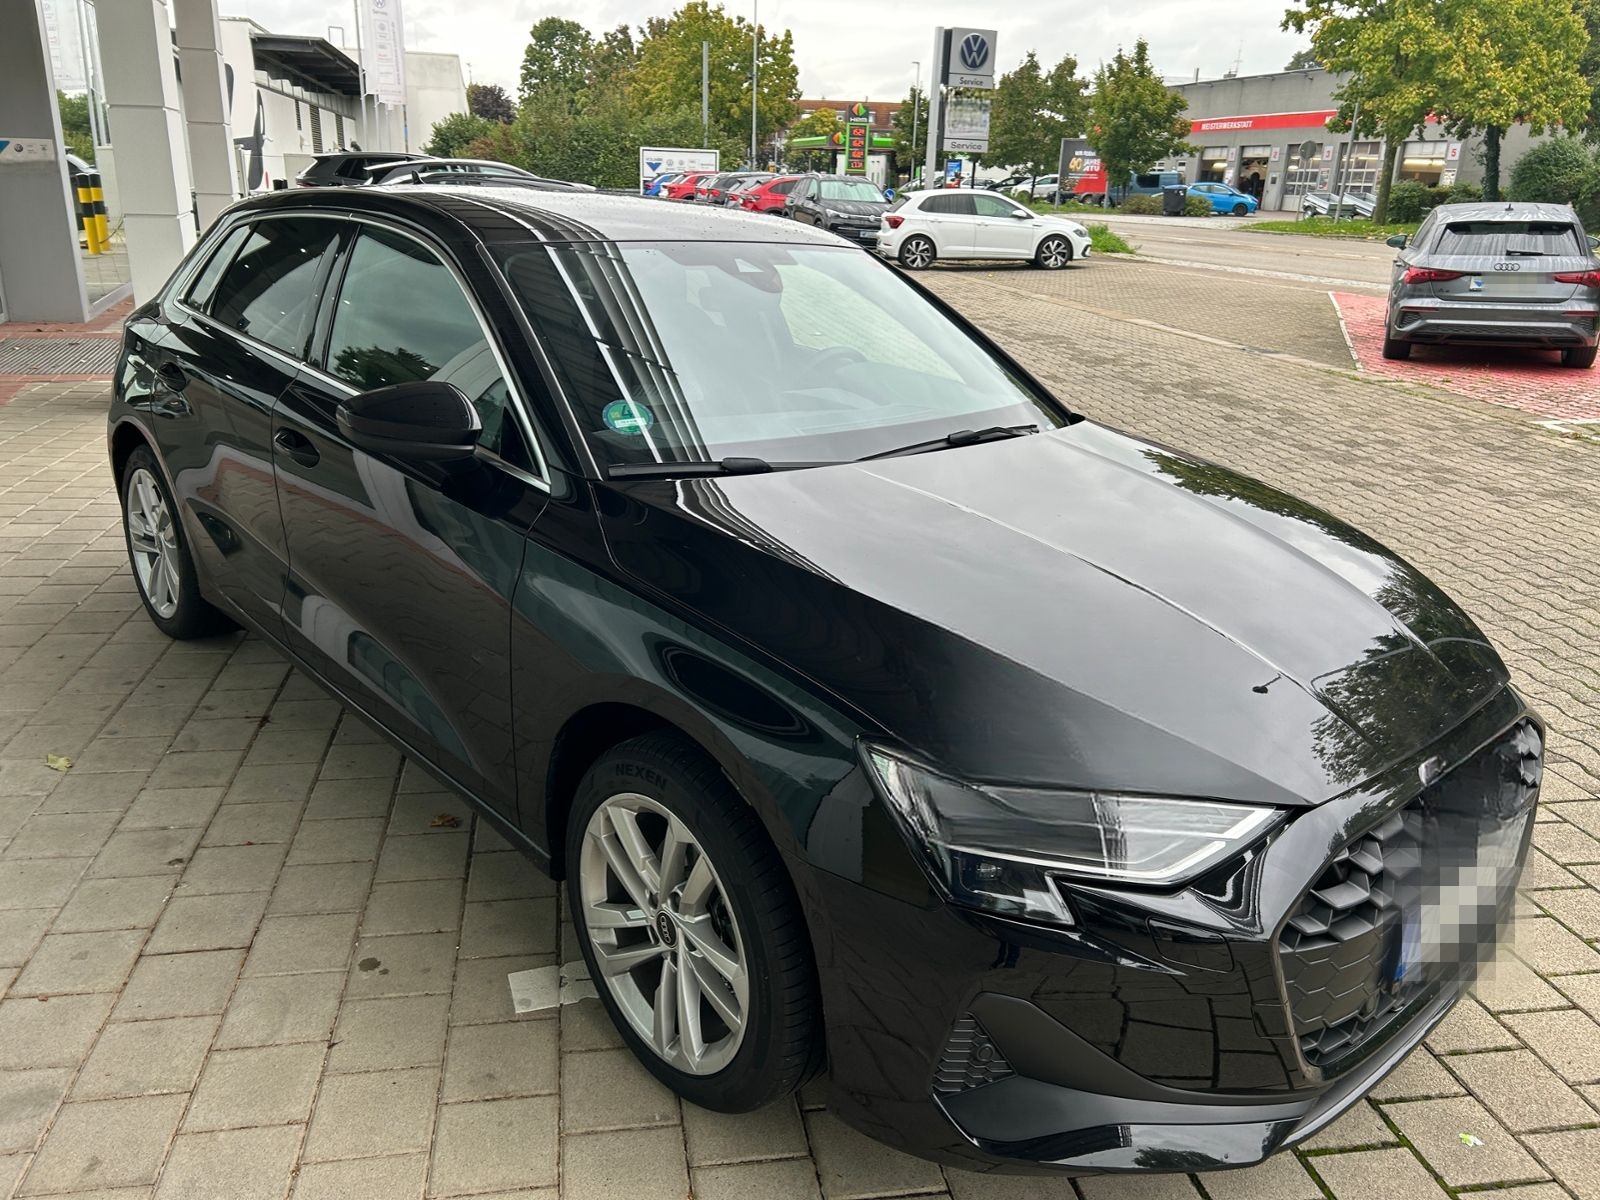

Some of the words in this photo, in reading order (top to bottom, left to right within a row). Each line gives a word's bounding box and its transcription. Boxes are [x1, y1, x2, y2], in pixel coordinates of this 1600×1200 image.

[959, 77, 984, 87] Service
[1201, 120, 1253, 130] MEISTERWERKSTATT
[951, 141, 982, 150] Service
[1069, 156, 1083, 171] 40
[616, 763, 667, 791] NEXEN
